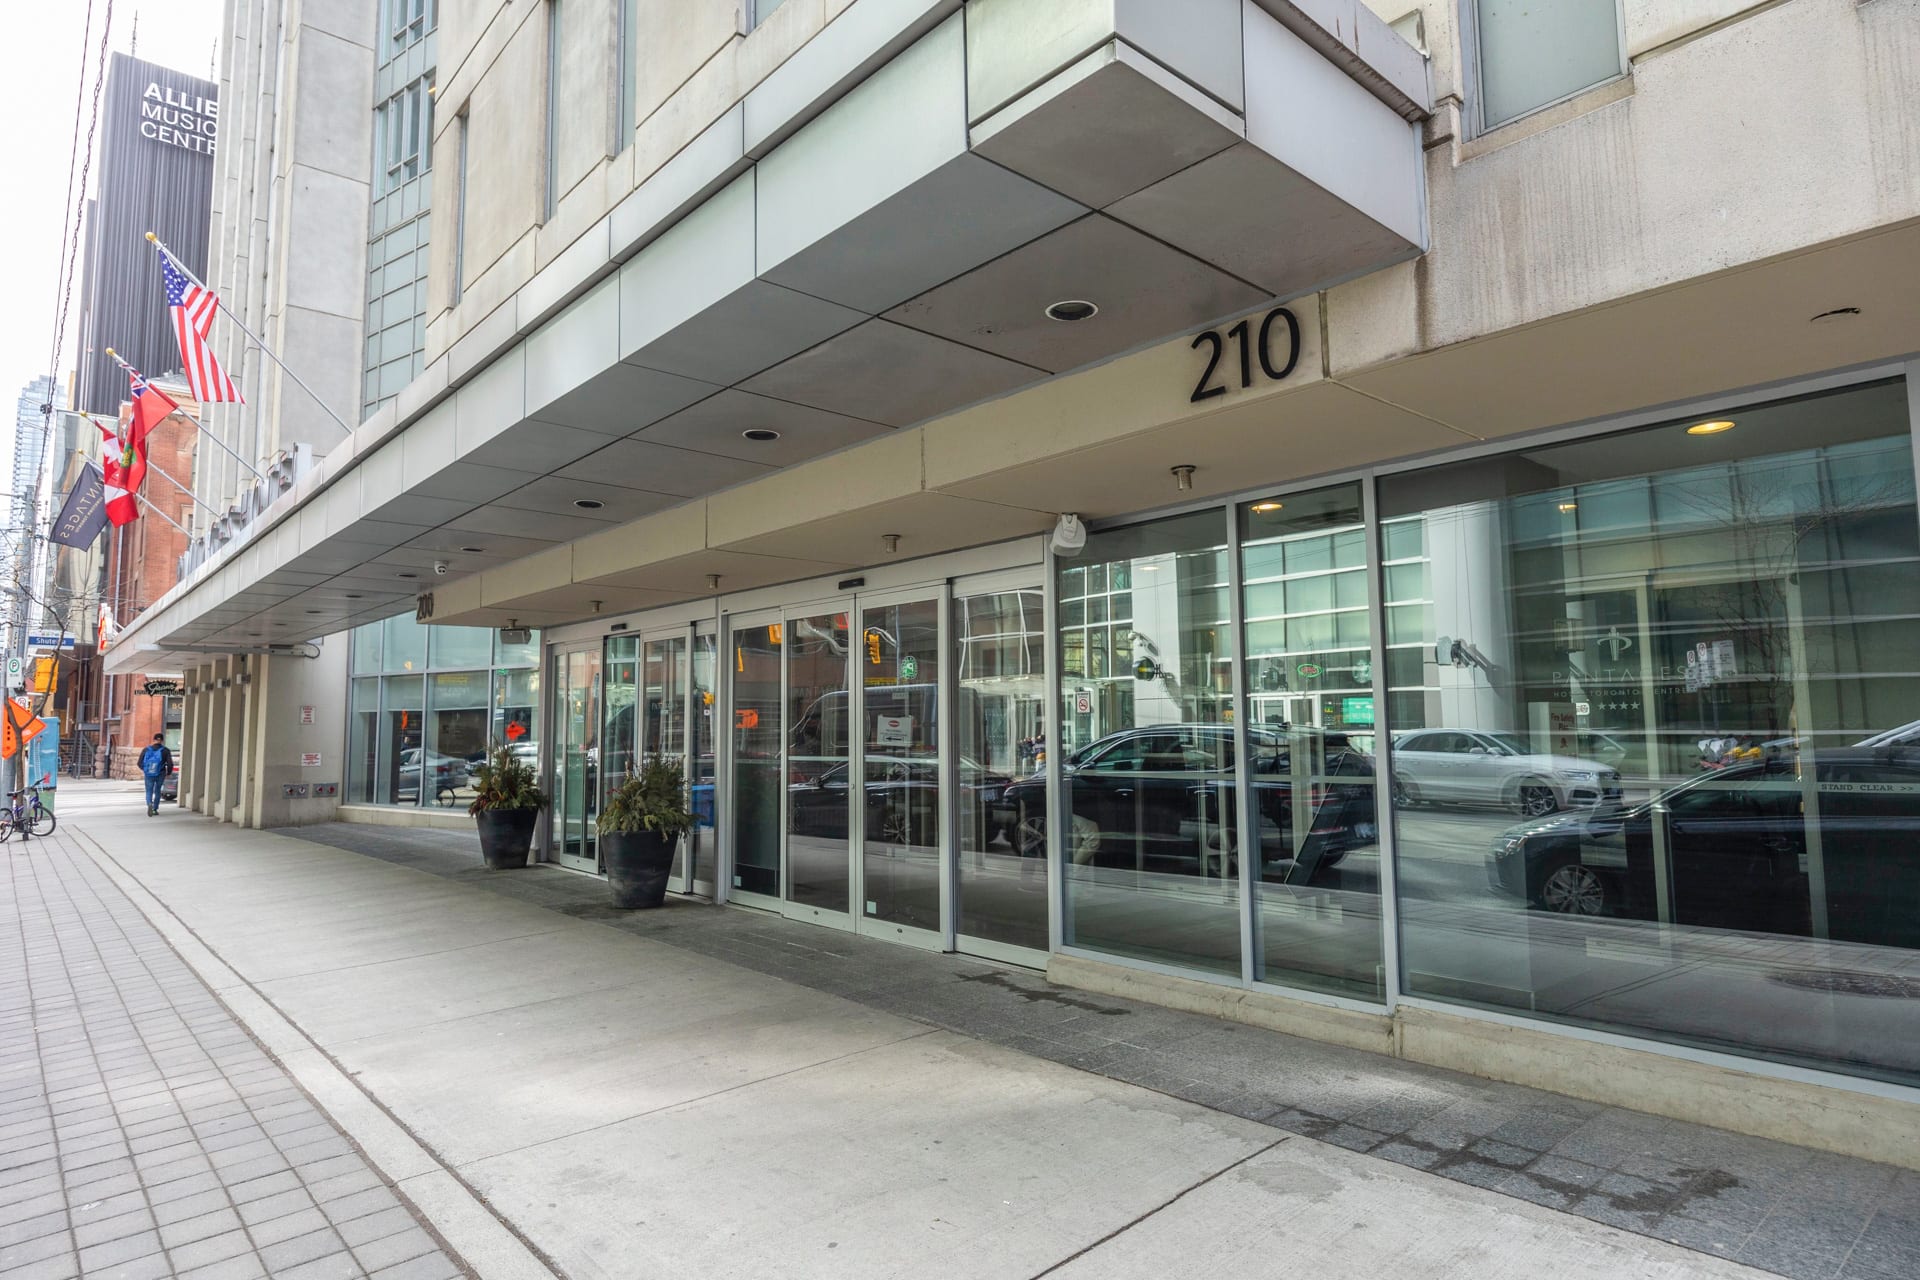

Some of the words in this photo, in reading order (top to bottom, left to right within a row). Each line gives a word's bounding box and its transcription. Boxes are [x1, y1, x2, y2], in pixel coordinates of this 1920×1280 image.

[1190, 308, 1300, 404] 210
[416, 592, 435, 621] 200
[1553, 665, 1687, 683] PANTAES
[1590, 688, 1641, 697] TORONTO
[1821, 783, 1853, 791] STAND
[1860, 784, 1894, 792] CLEAR
